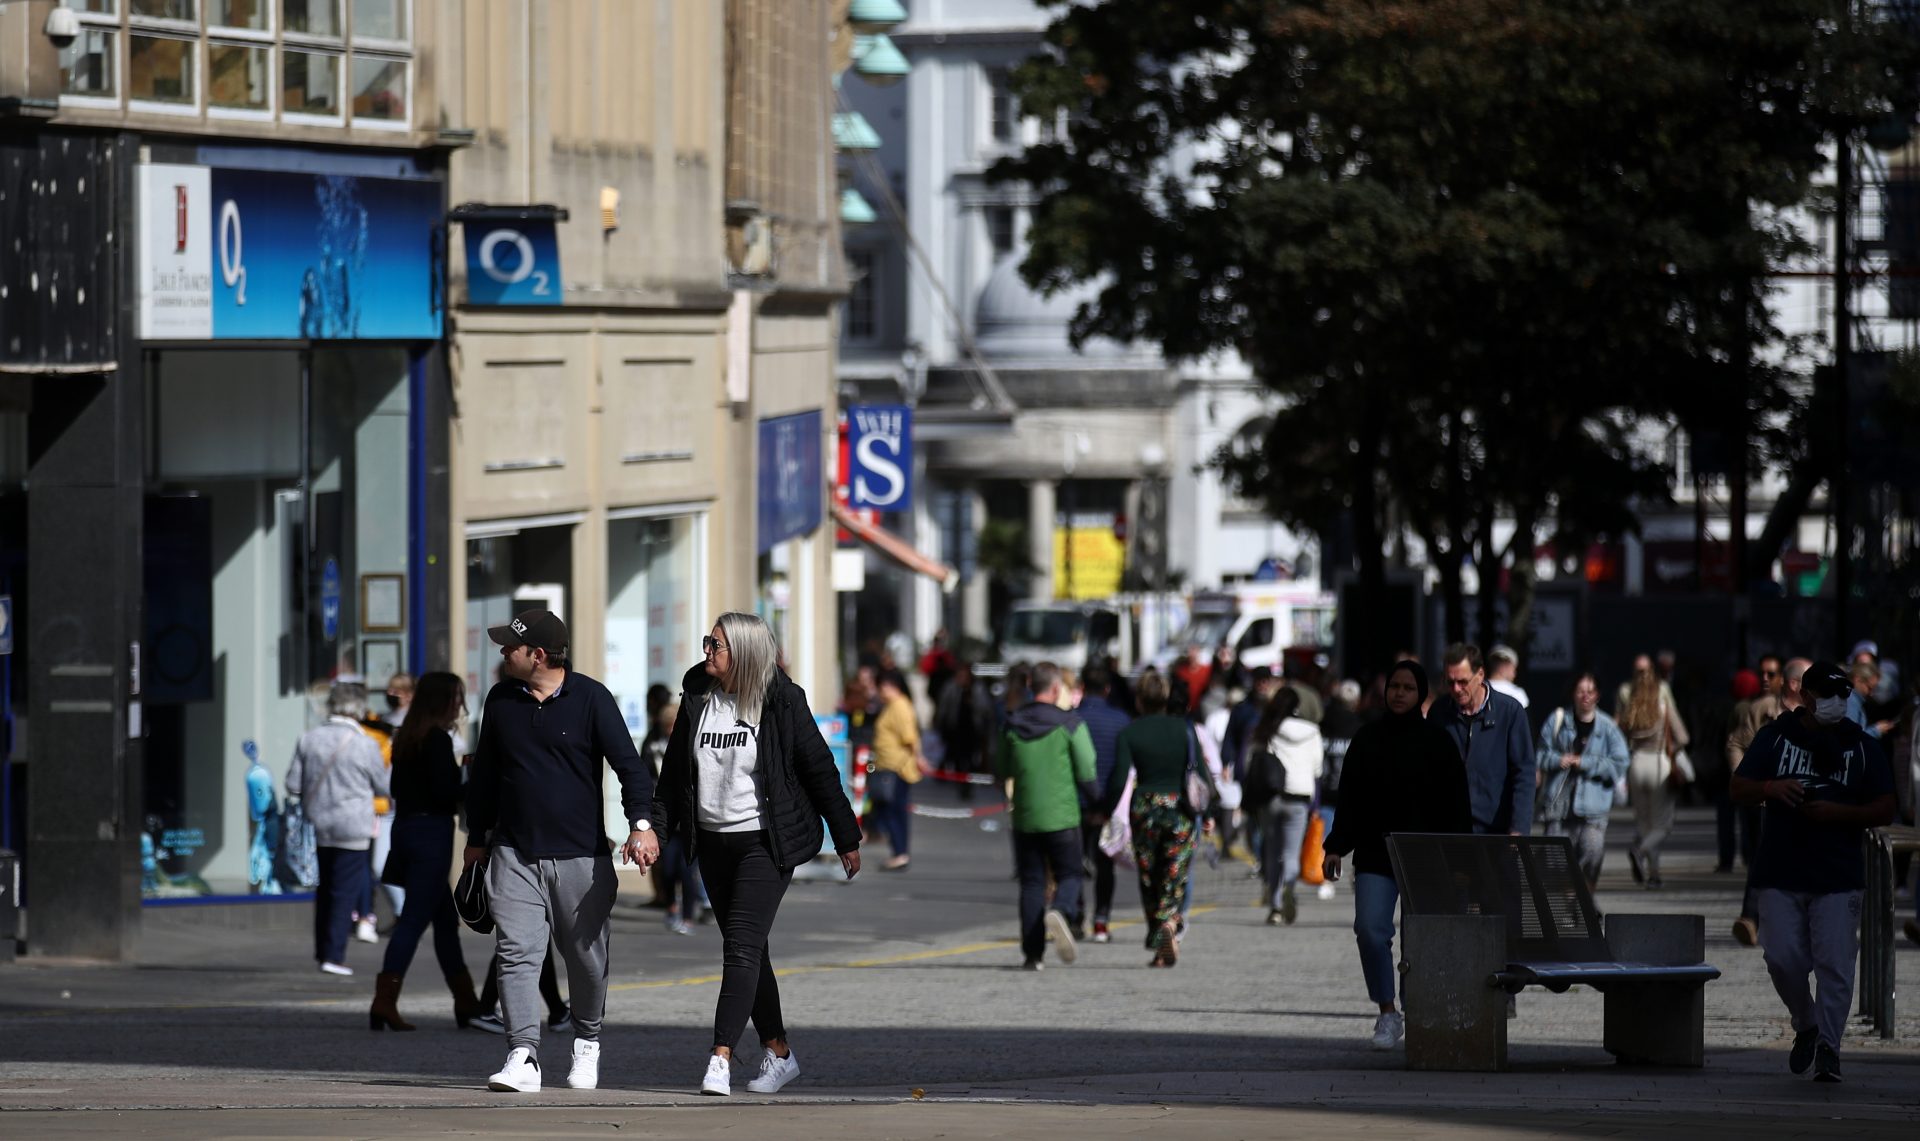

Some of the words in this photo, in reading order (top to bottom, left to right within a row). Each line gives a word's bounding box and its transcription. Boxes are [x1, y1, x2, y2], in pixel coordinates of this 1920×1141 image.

[220, 199, 246, 305] O2
[479, 228, 551, 296] O2
[512, 618, 528, 633] EA7
[699, 731, 748, 749] PUMA
